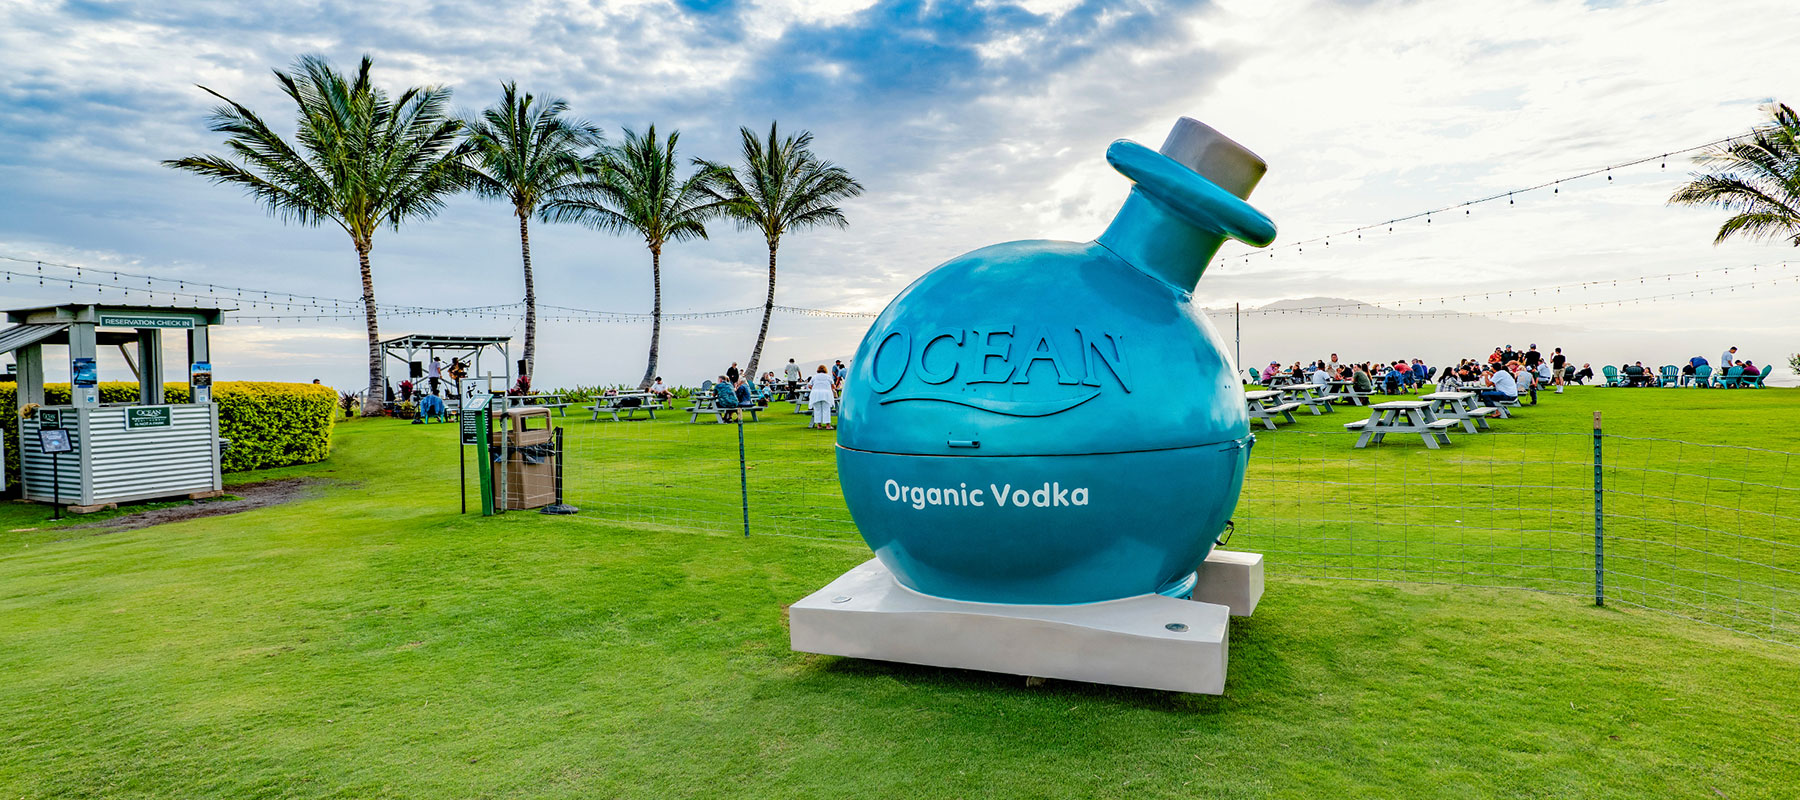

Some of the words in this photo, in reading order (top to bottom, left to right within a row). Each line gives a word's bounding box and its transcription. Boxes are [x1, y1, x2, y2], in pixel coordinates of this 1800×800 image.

[105, 318, 155, 326] RESERVATION
[156, 319, 181, 327] CHECK
[870, 325, 1132, 394] OCEAN
[884, 479, 985, 510] Organic
[990, 482, 1089, 508] Vodka
